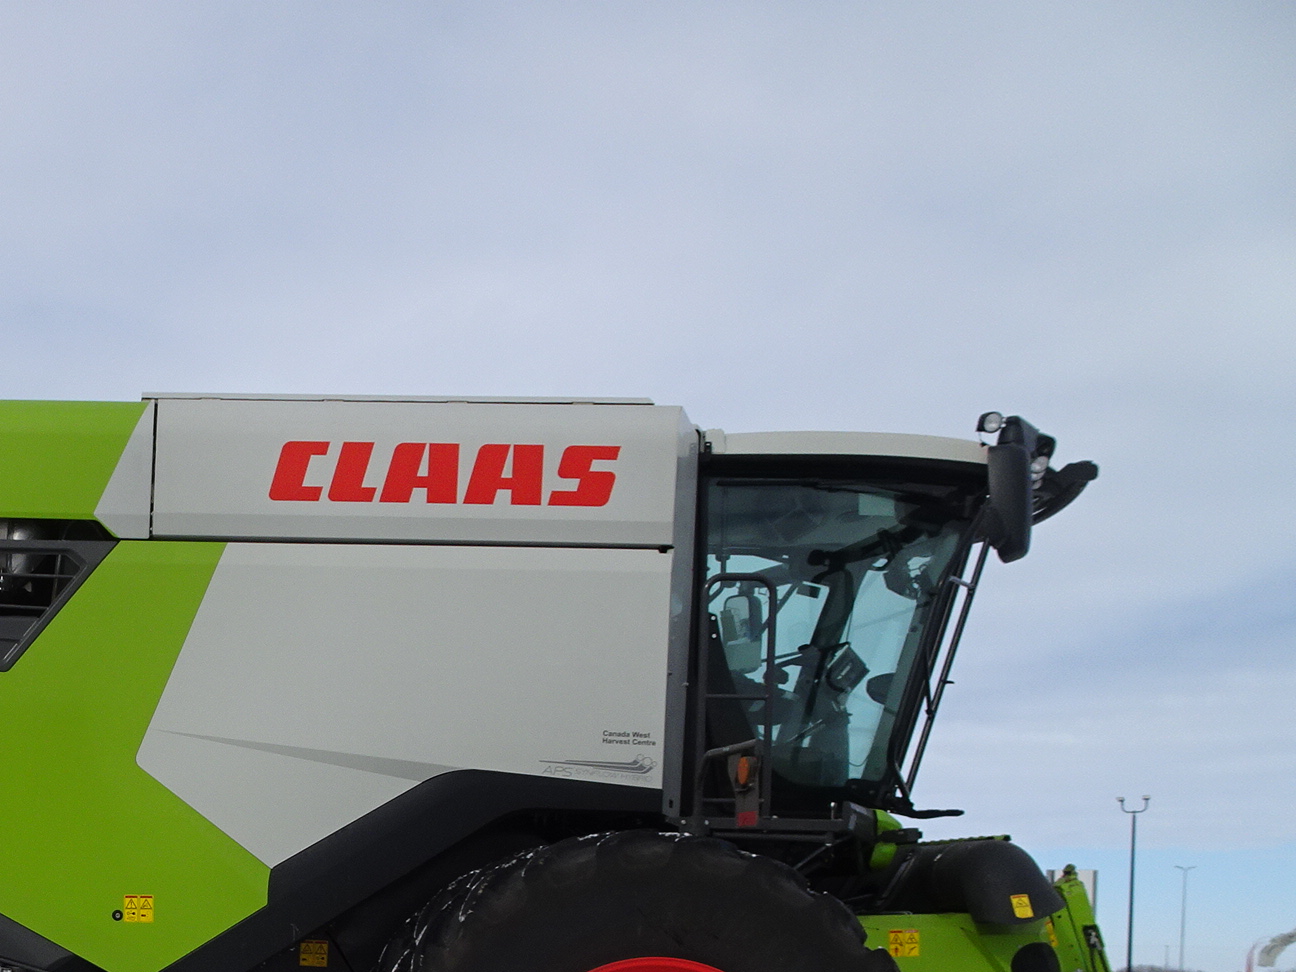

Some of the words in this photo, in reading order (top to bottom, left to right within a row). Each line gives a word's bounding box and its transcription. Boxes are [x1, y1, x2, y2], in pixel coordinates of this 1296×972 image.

[268, 440, 622, 508] CLAAS
[602, 730, 630, 738] Canada
[632, 738, 657, 746] Centre
[542, 765, 573, 777] APS
